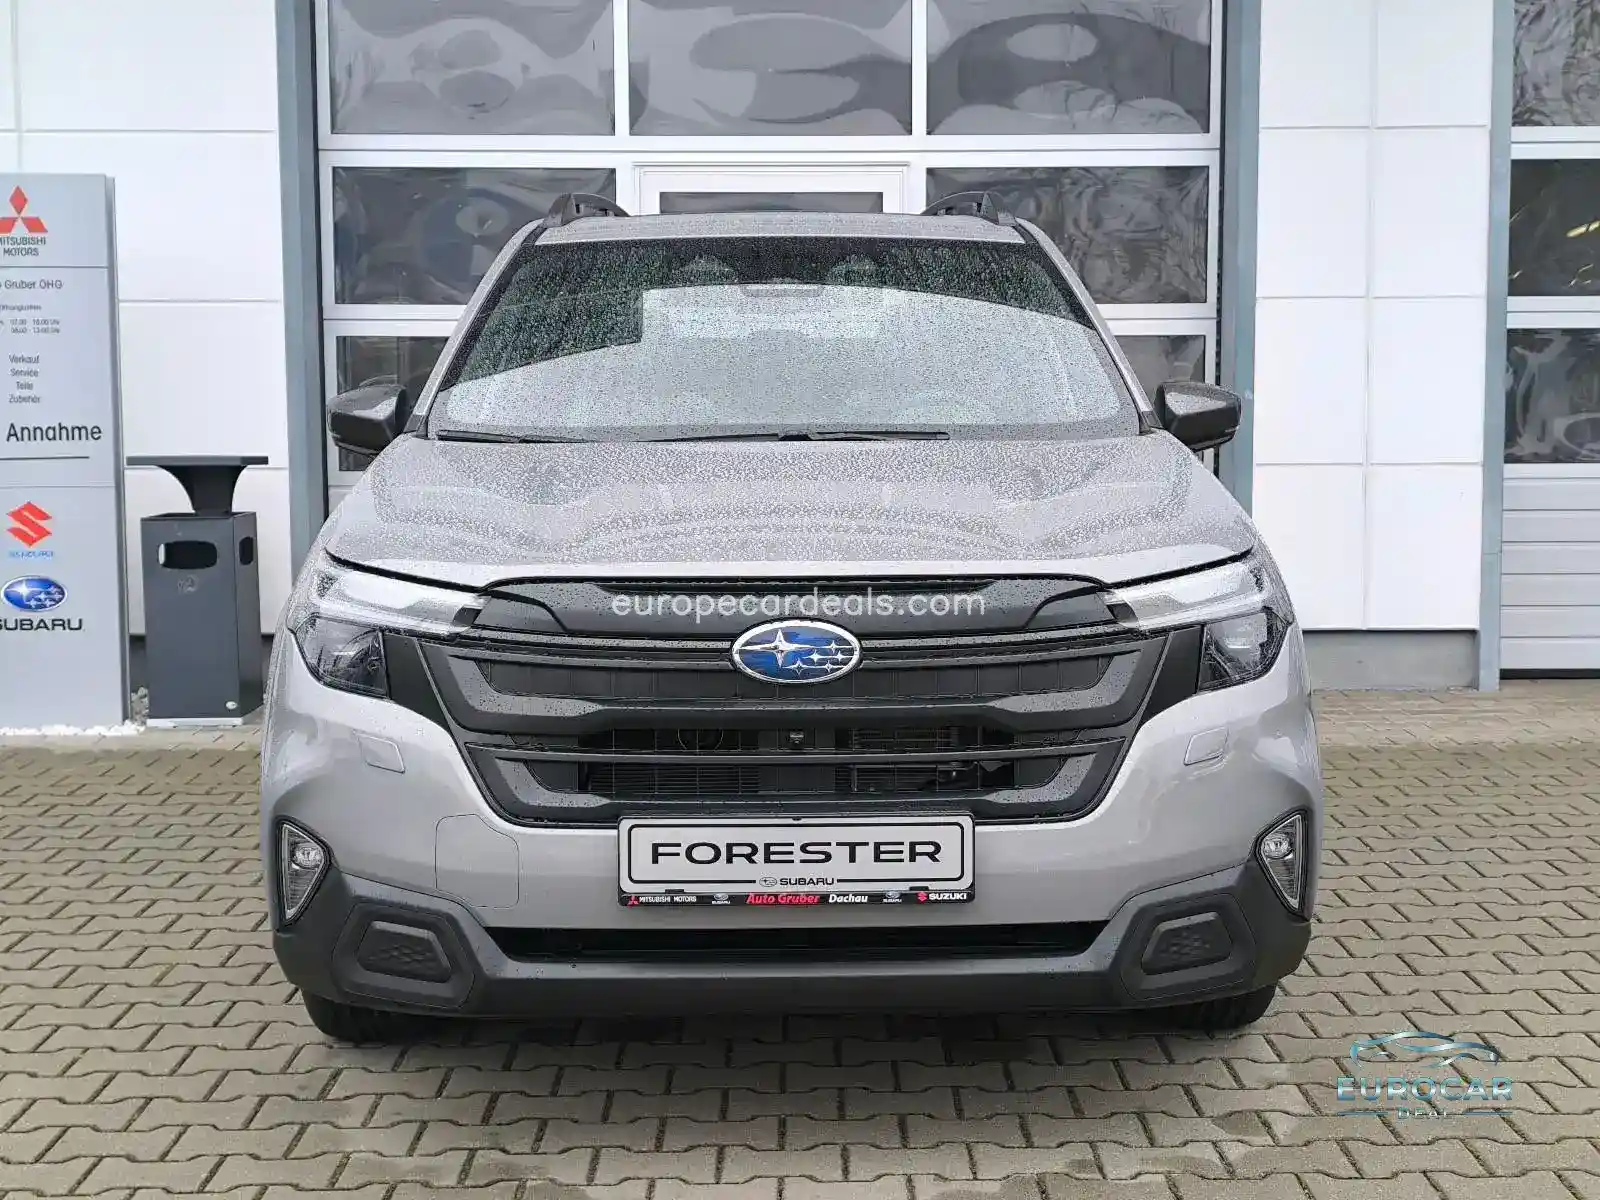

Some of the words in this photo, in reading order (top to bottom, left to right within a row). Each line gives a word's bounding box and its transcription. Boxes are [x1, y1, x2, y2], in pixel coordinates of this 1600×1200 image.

[3, 247, 39, 256] MOTORS
[4, 279, 36, 289] Gruber
[39, 279, 63, 289] OHG
[8, 354, 40, 364] Verkauf
[10, 368, 39, 377] Service
[16, 381, 34, 390] Teile
[6, 422, 102, 442] Annahme
[0, 618, 83, 631] UBARU
[650, 840, 942, 865] FORESTER
[779, 877, 835, 886] SUBARU
[746, 893, 775, 904] Auto
[777, 892, 820, 904] Gruber
[828, 893, 868, 903] Dachau
[928, 892, 967, 900] SUZUKI
